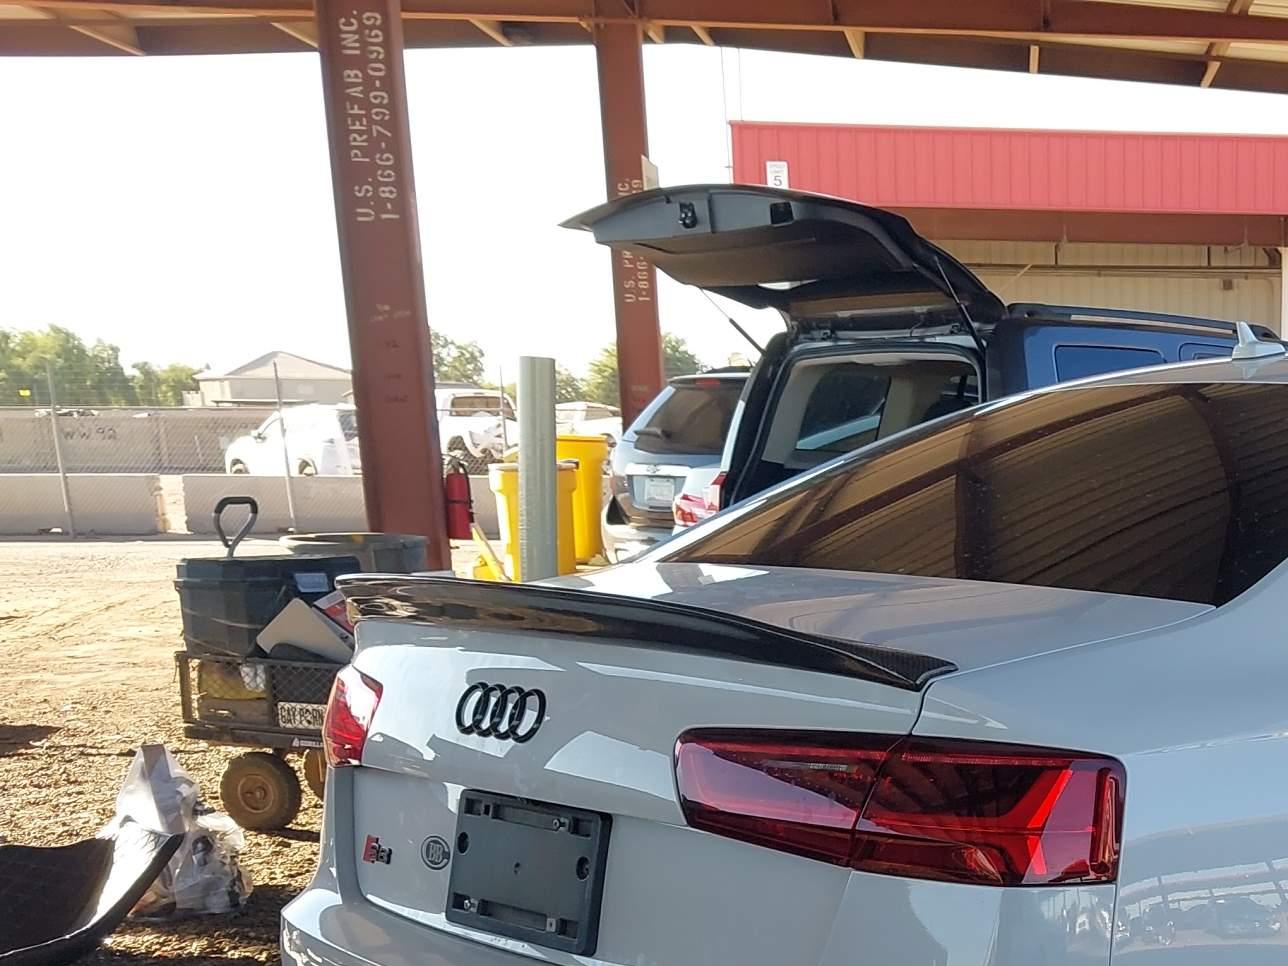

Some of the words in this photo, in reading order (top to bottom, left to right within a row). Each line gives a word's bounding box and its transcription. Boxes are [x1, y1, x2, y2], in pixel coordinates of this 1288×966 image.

[338, 10, 360, 55] INC.
[343, 68, 370, 162] PREFAB
[362, 12, 400, 219] 1-866-799-0969
[354, 177, 376, 222] U.S.
[774, 175, 783, 186] 5
